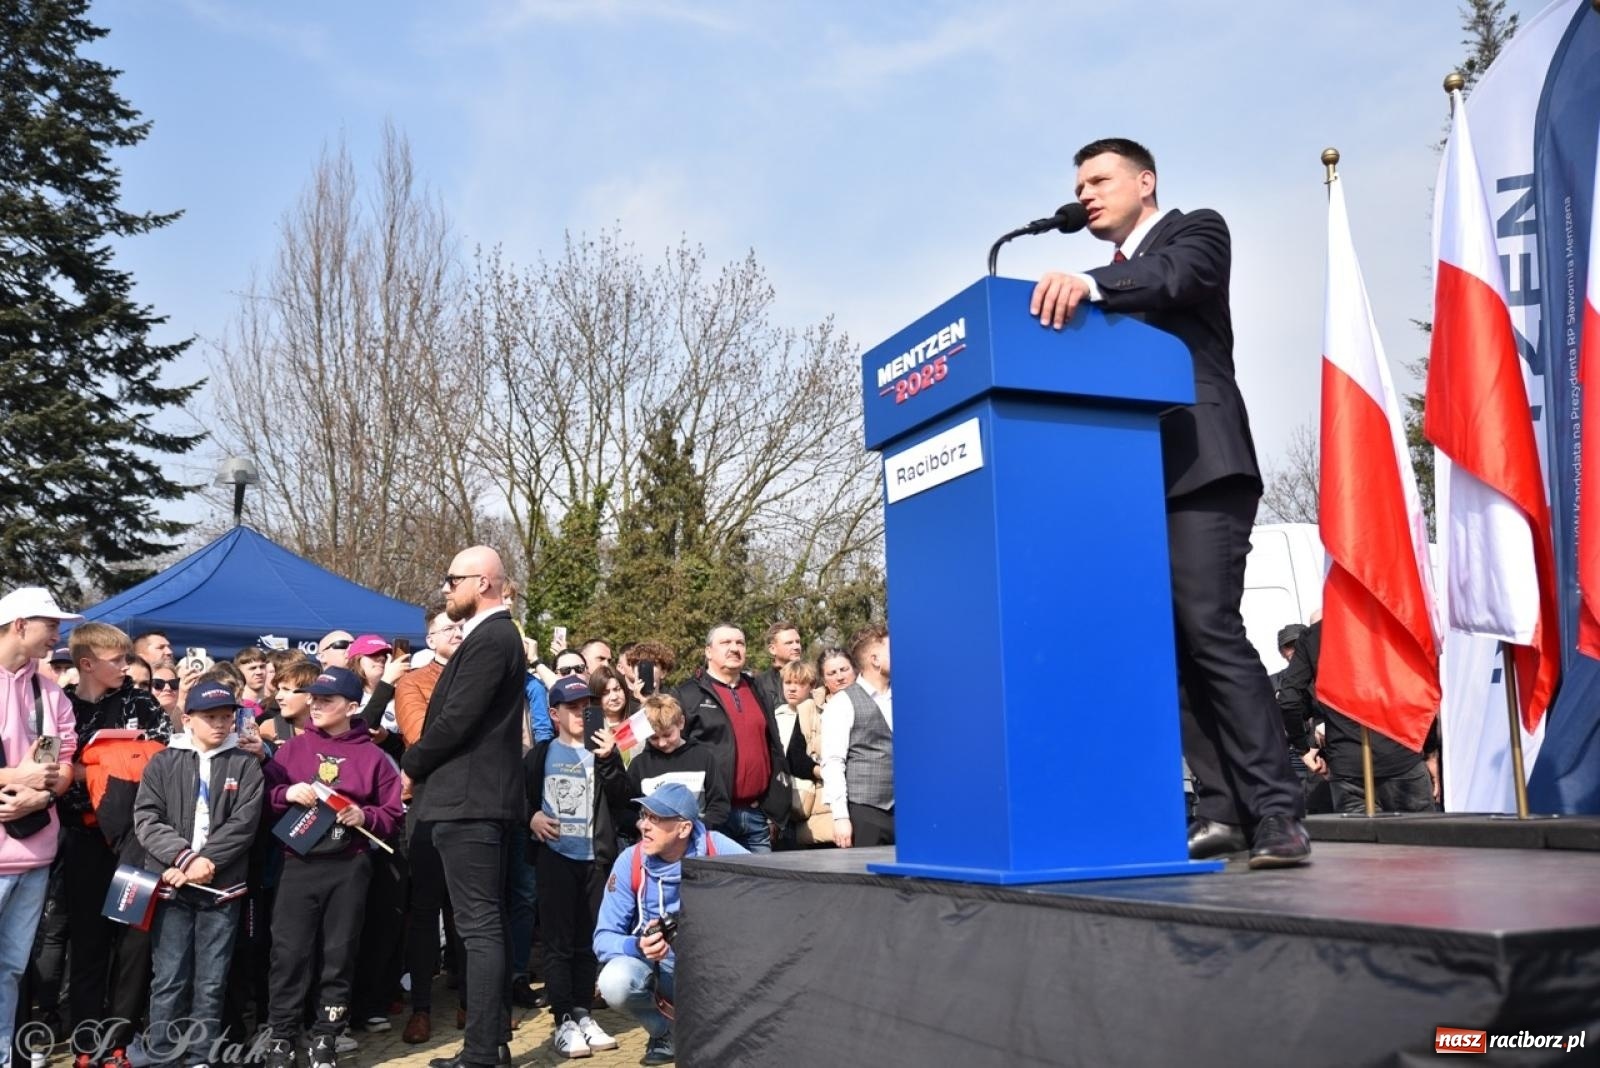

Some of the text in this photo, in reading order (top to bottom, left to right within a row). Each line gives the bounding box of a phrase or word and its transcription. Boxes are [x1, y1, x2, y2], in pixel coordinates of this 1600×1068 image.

[1564, 196, 1574, 258] Mentzena
[1566, 259, 1576, 326] Sławomira
[877, 317, 966, 388] MENTZEN
[1567, 328, 1576, 346] RP
[895, 355, 948, 404] 2025
[1569, 348, 1581, 420] Prezydenta
[1572, 423, 1581, 439] na
[896, 442, 968, 485] Racibórz
